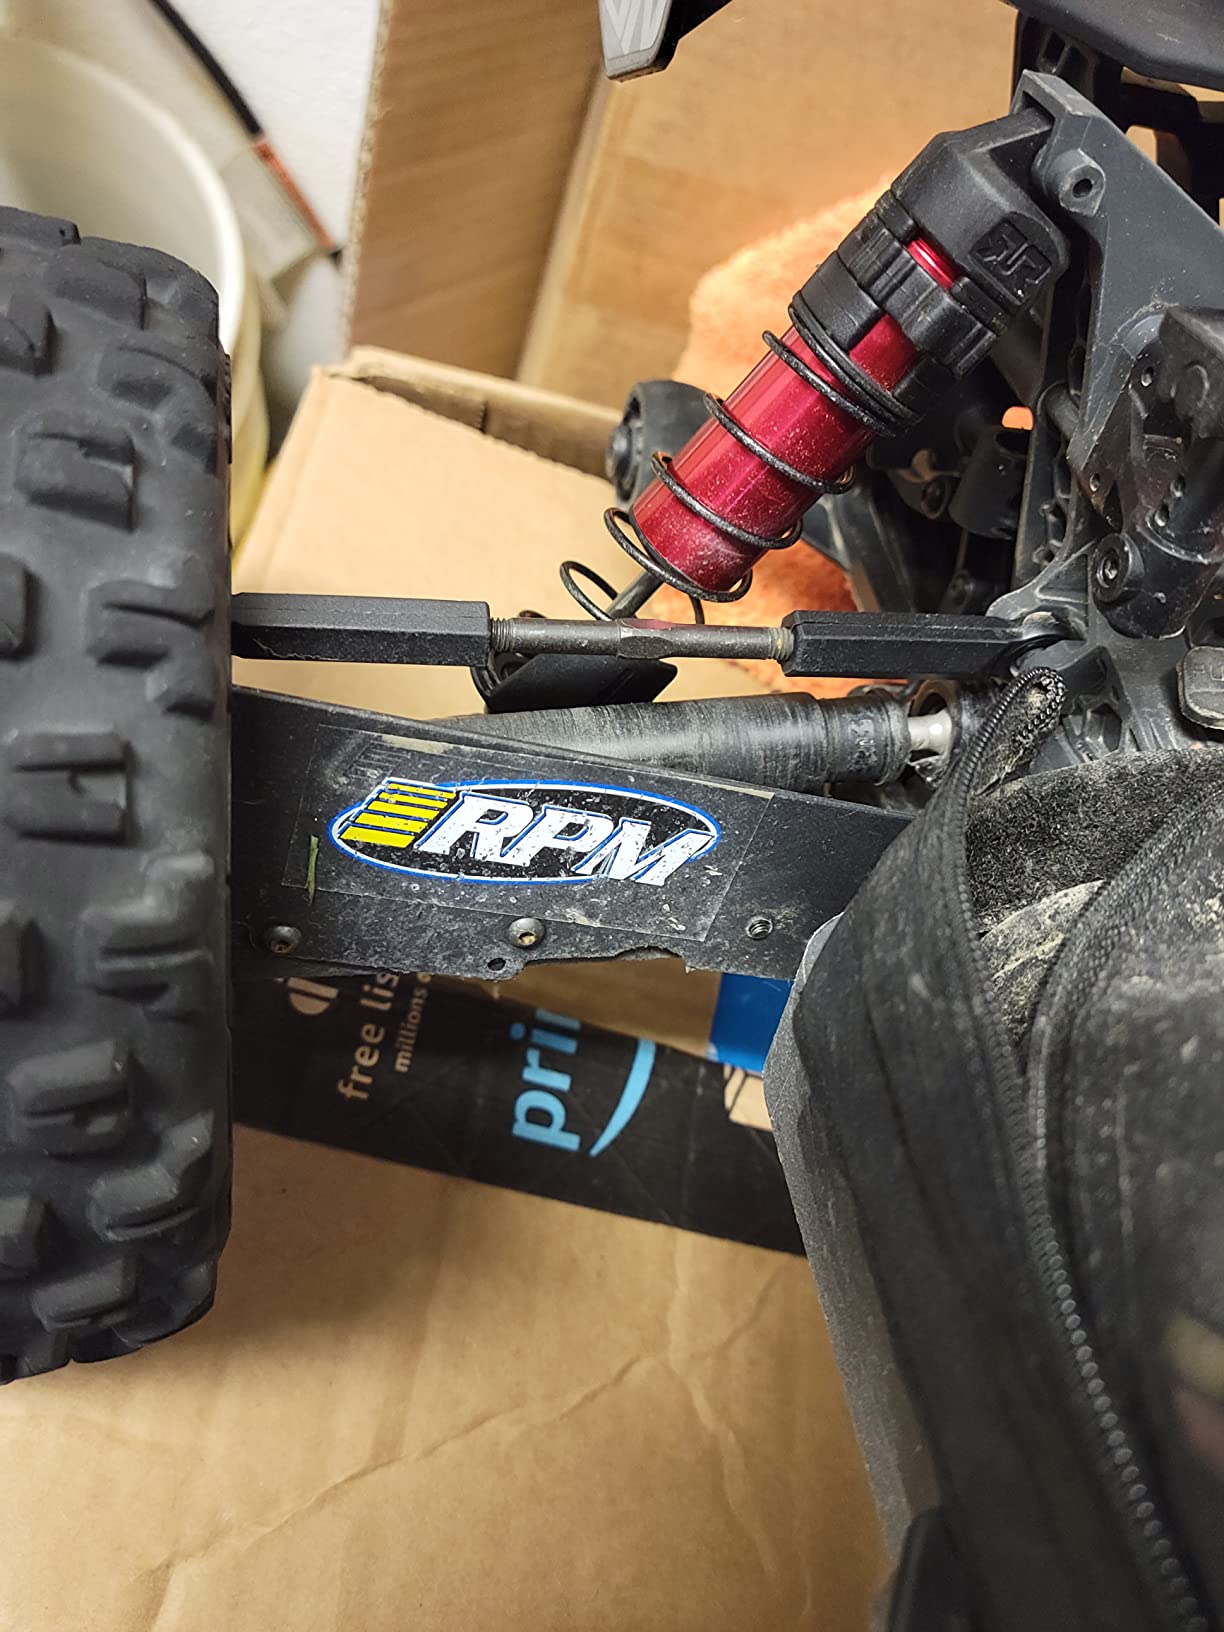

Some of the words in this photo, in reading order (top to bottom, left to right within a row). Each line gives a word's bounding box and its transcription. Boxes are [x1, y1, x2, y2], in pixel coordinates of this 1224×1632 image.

[413, 791, 714, 887] RPM
[336, 1023, 385, 1100] free
[394, 986, 428, 1073] millions
